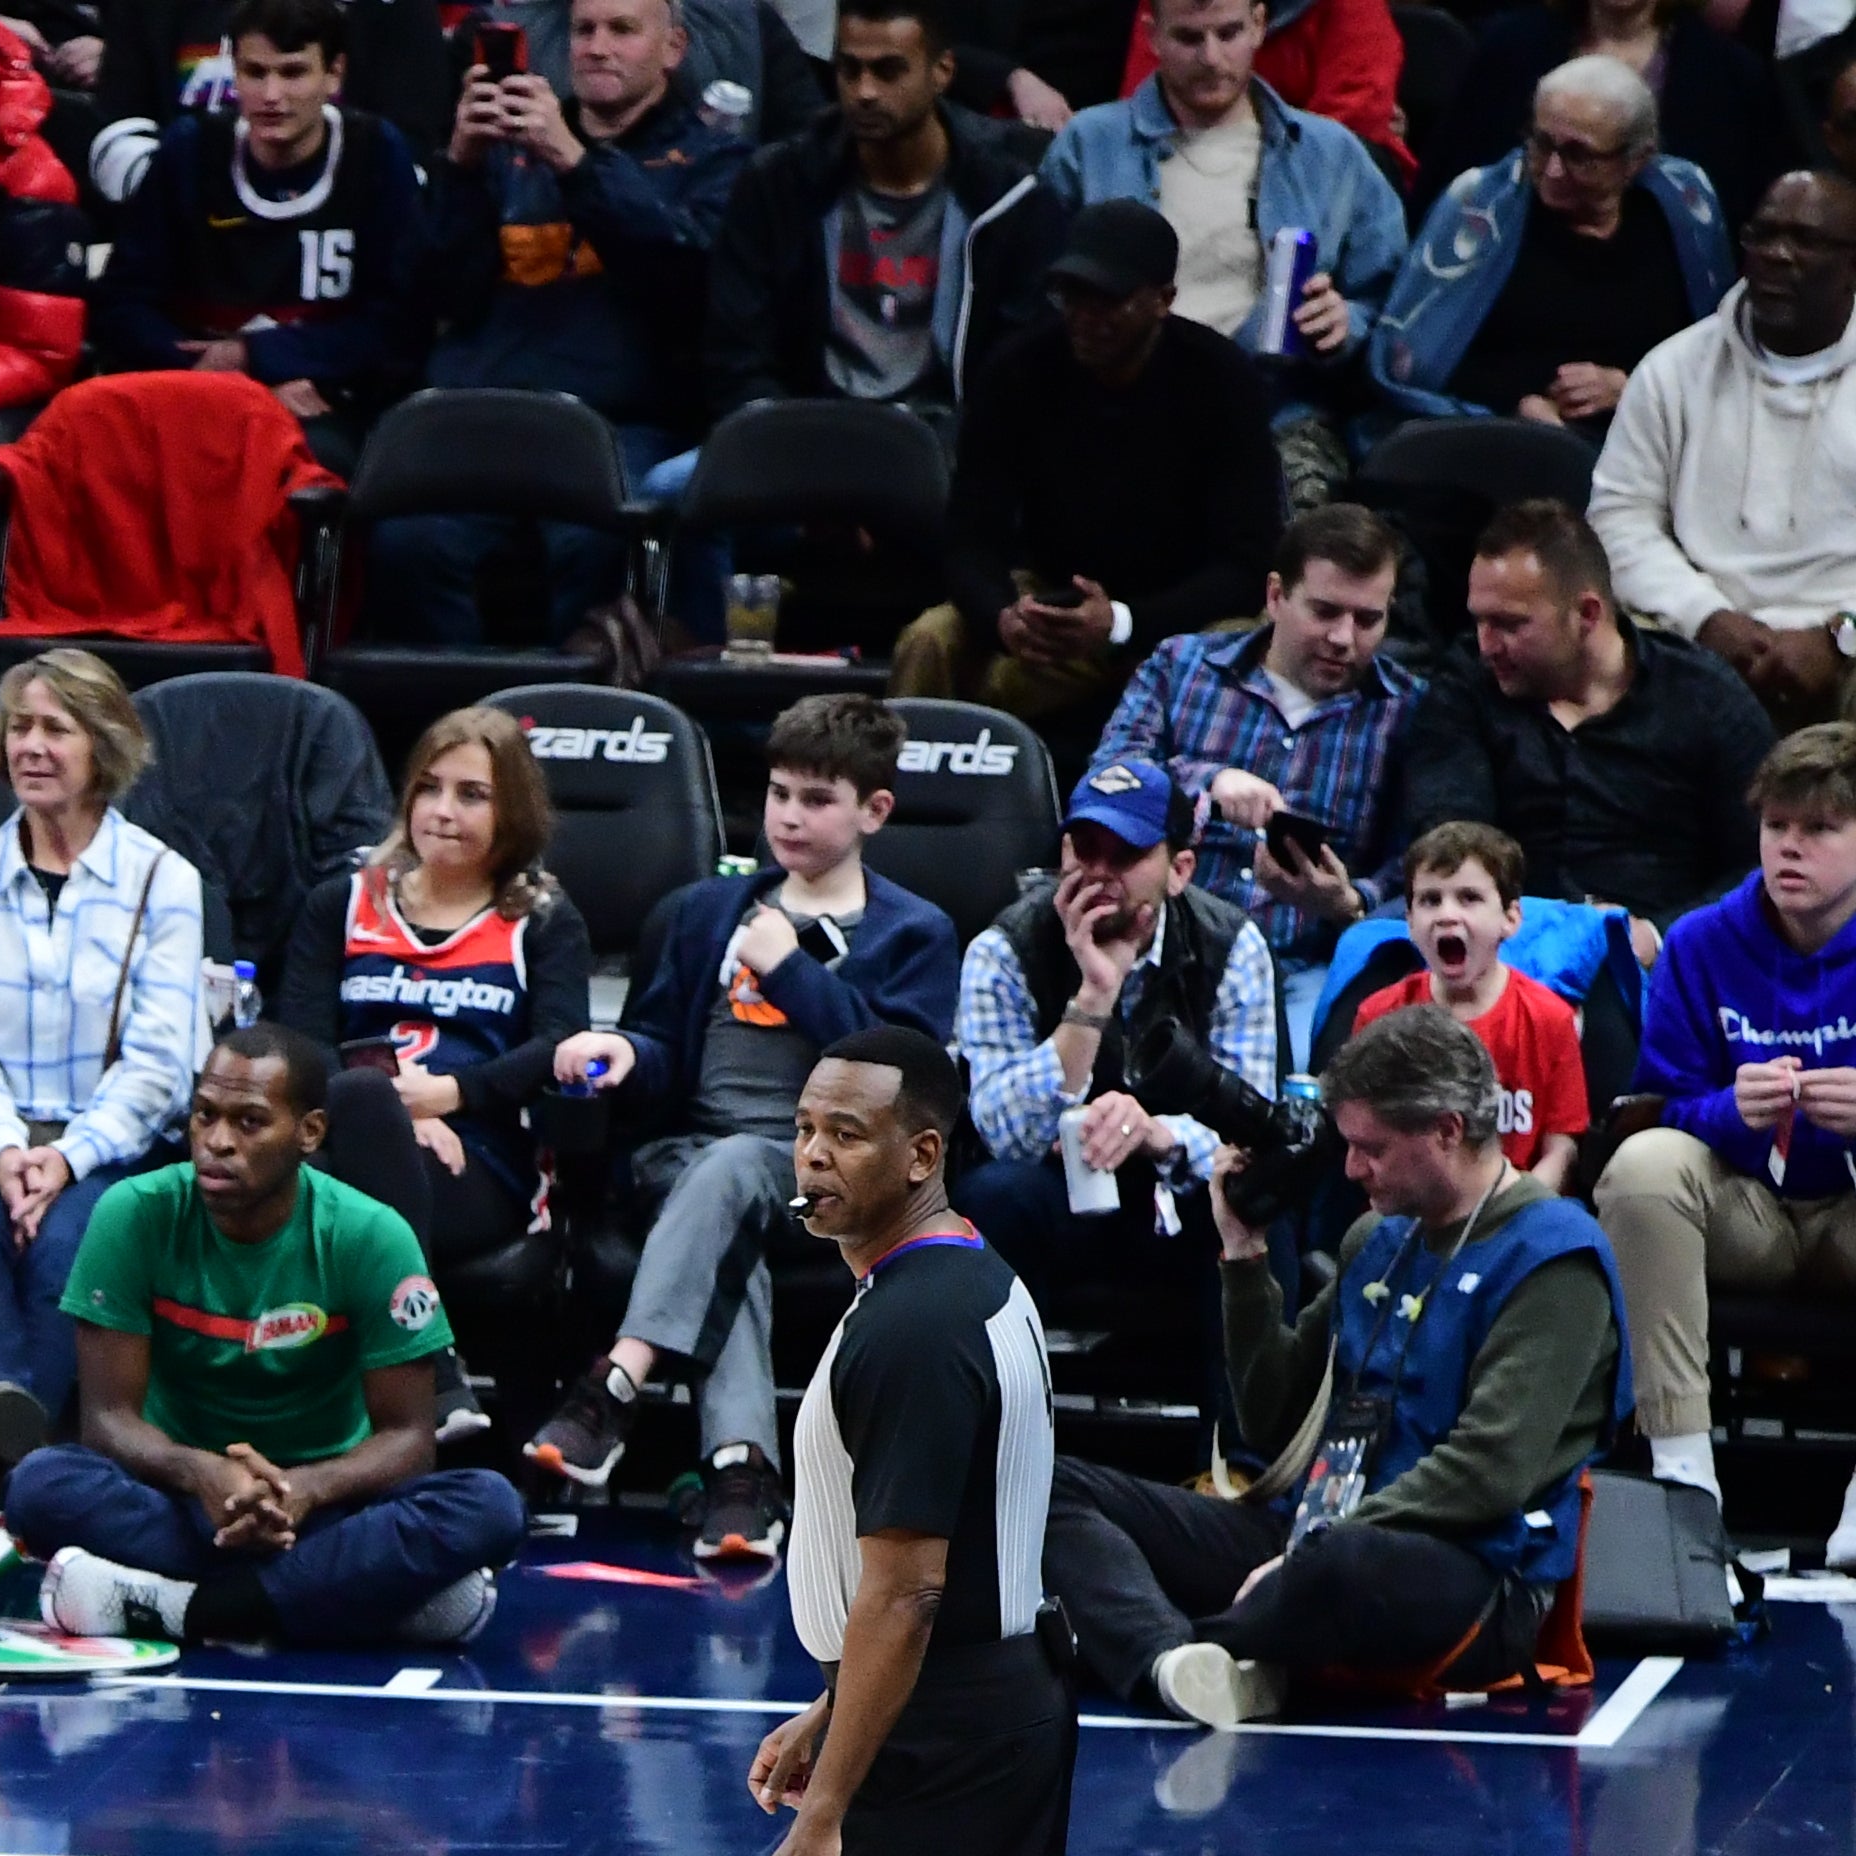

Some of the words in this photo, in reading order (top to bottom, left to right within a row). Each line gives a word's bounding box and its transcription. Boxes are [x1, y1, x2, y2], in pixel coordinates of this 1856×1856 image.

[298, 229, 356, 300] 15
[519, 715, 674, 763] zards
[896, 728, 1019, 775] ards
